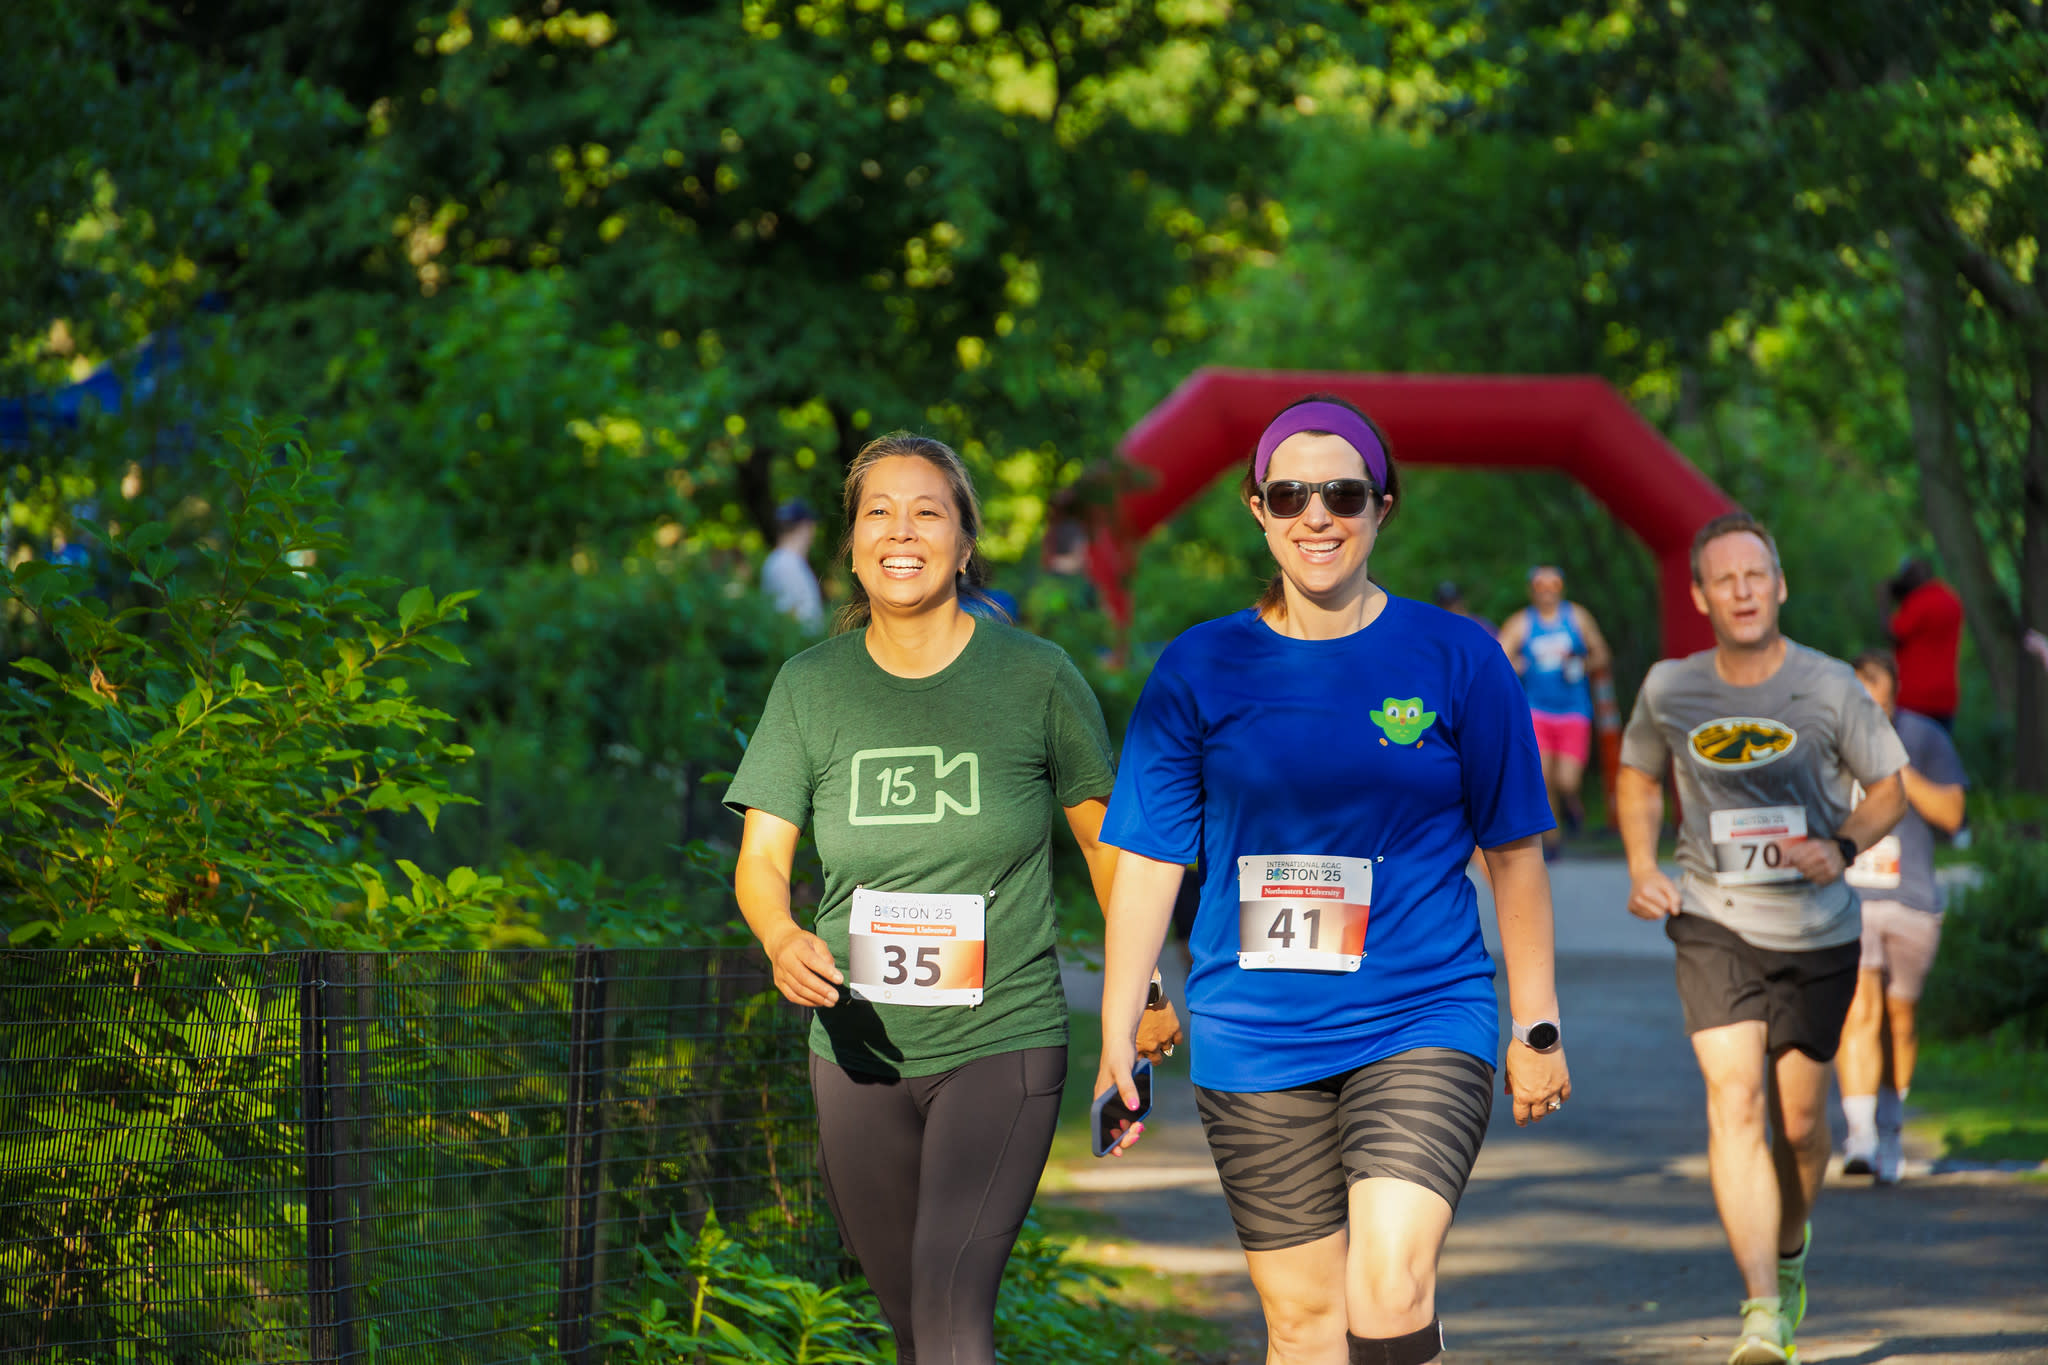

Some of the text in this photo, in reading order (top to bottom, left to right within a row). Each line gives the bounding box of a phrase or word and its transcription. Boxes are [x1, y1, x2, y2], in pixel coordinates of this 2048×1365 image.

[876, 766, 916, 806] 15
[1266, 861, 1319, 869] INTERNATIONAL
[1741, 842, 1782, 870] 70
[1321, 869, 1341, 881] '25
[1267, 908, 1321, 949] 41
[883, 945, 941, 987] 35
